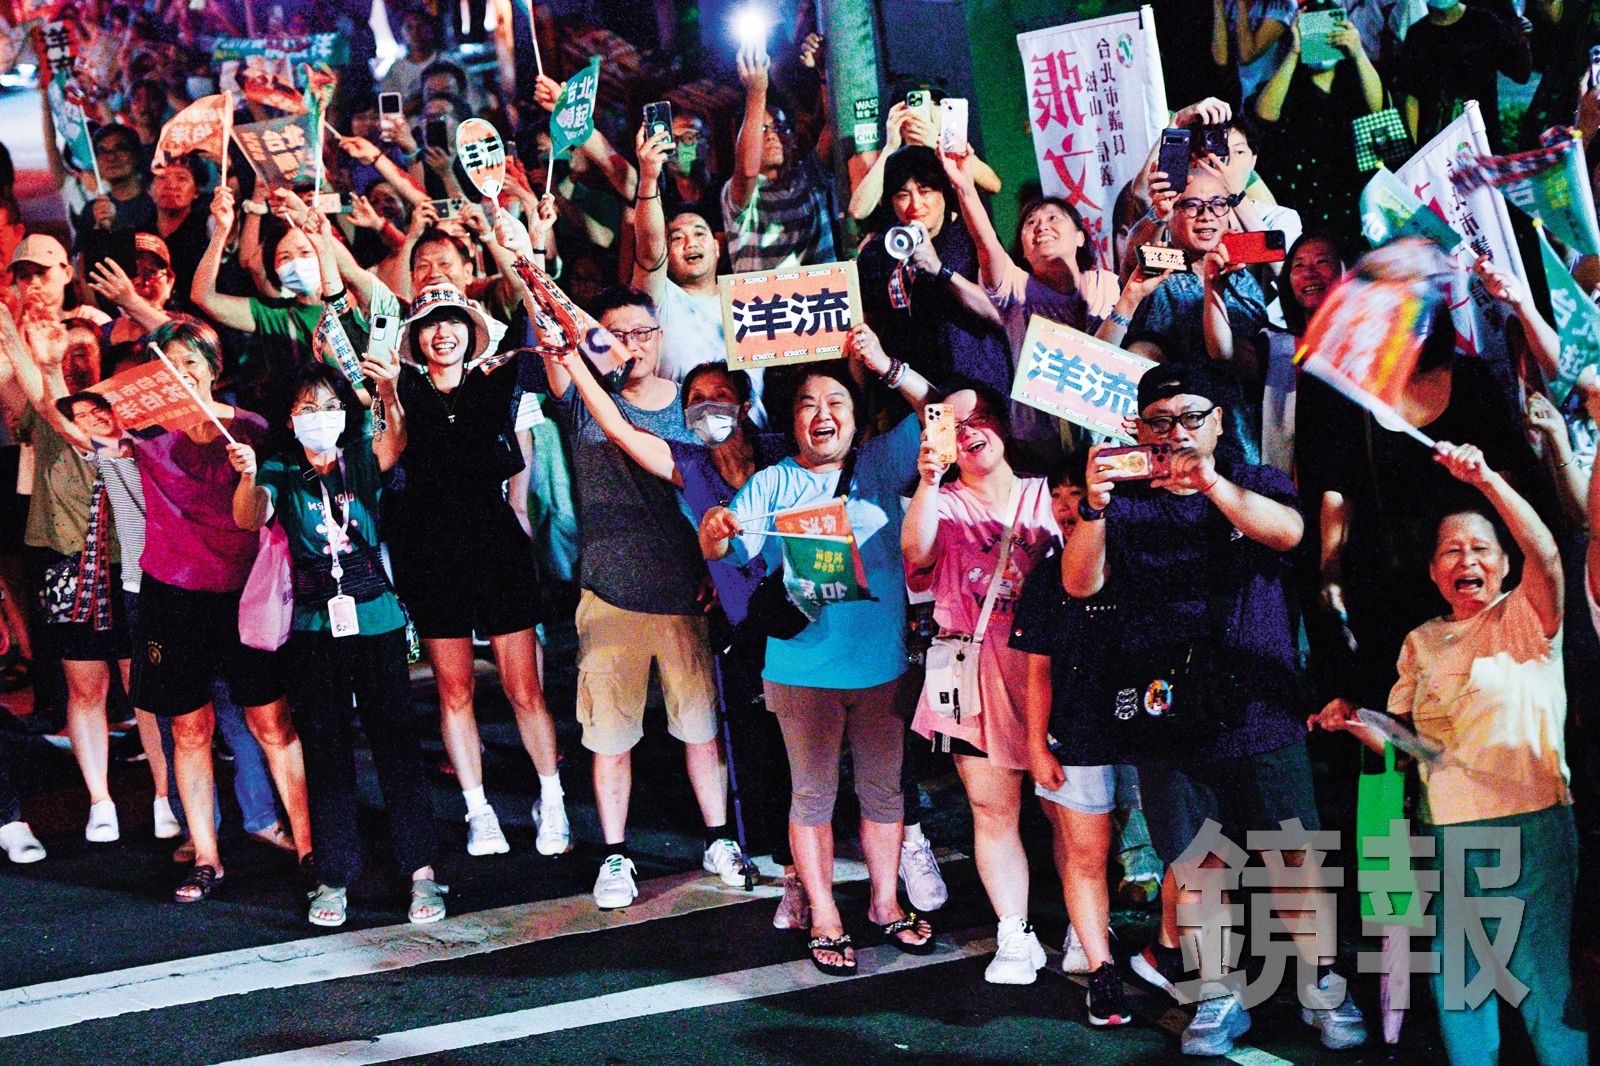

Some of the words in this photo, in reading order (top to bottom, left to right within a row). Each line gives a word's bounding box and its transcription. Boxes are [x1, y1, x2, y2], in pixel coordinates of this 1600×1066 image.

[567, 75, 594, 104] 台北
[732, 288, 851, 343] 洋流
[1027, 341, 1138, 416] 洋流
